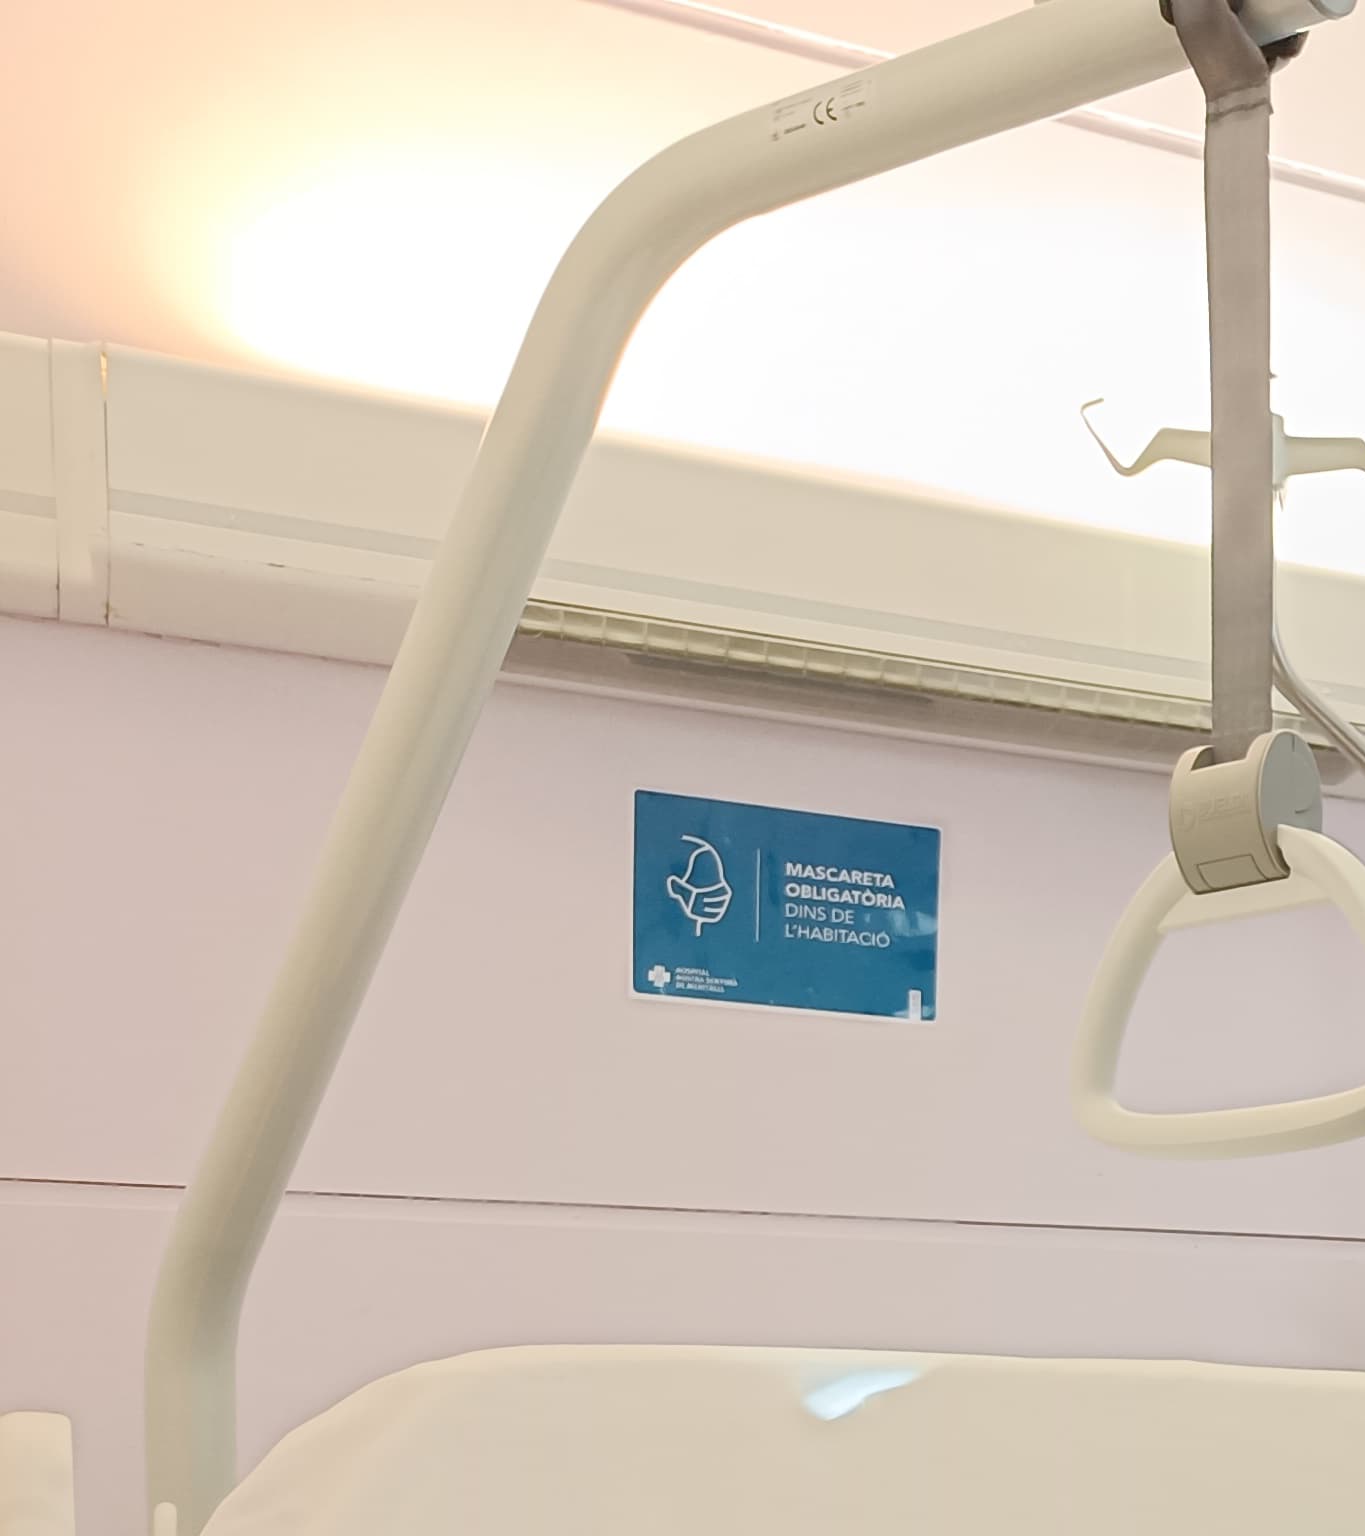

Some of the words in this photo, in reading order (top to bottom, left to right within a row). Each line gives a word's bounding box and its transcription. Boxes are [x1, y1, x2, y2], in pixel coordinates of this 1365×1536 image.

[784, 862, 895, 889] MASCARETA
[784, 883, 906, 910] OBLIGATÒRIA
[784, 903, 827, 923] DINS
[831, 907, 855, 925] DE
[784, 924, 891, 949] L'HABITACIÓ
